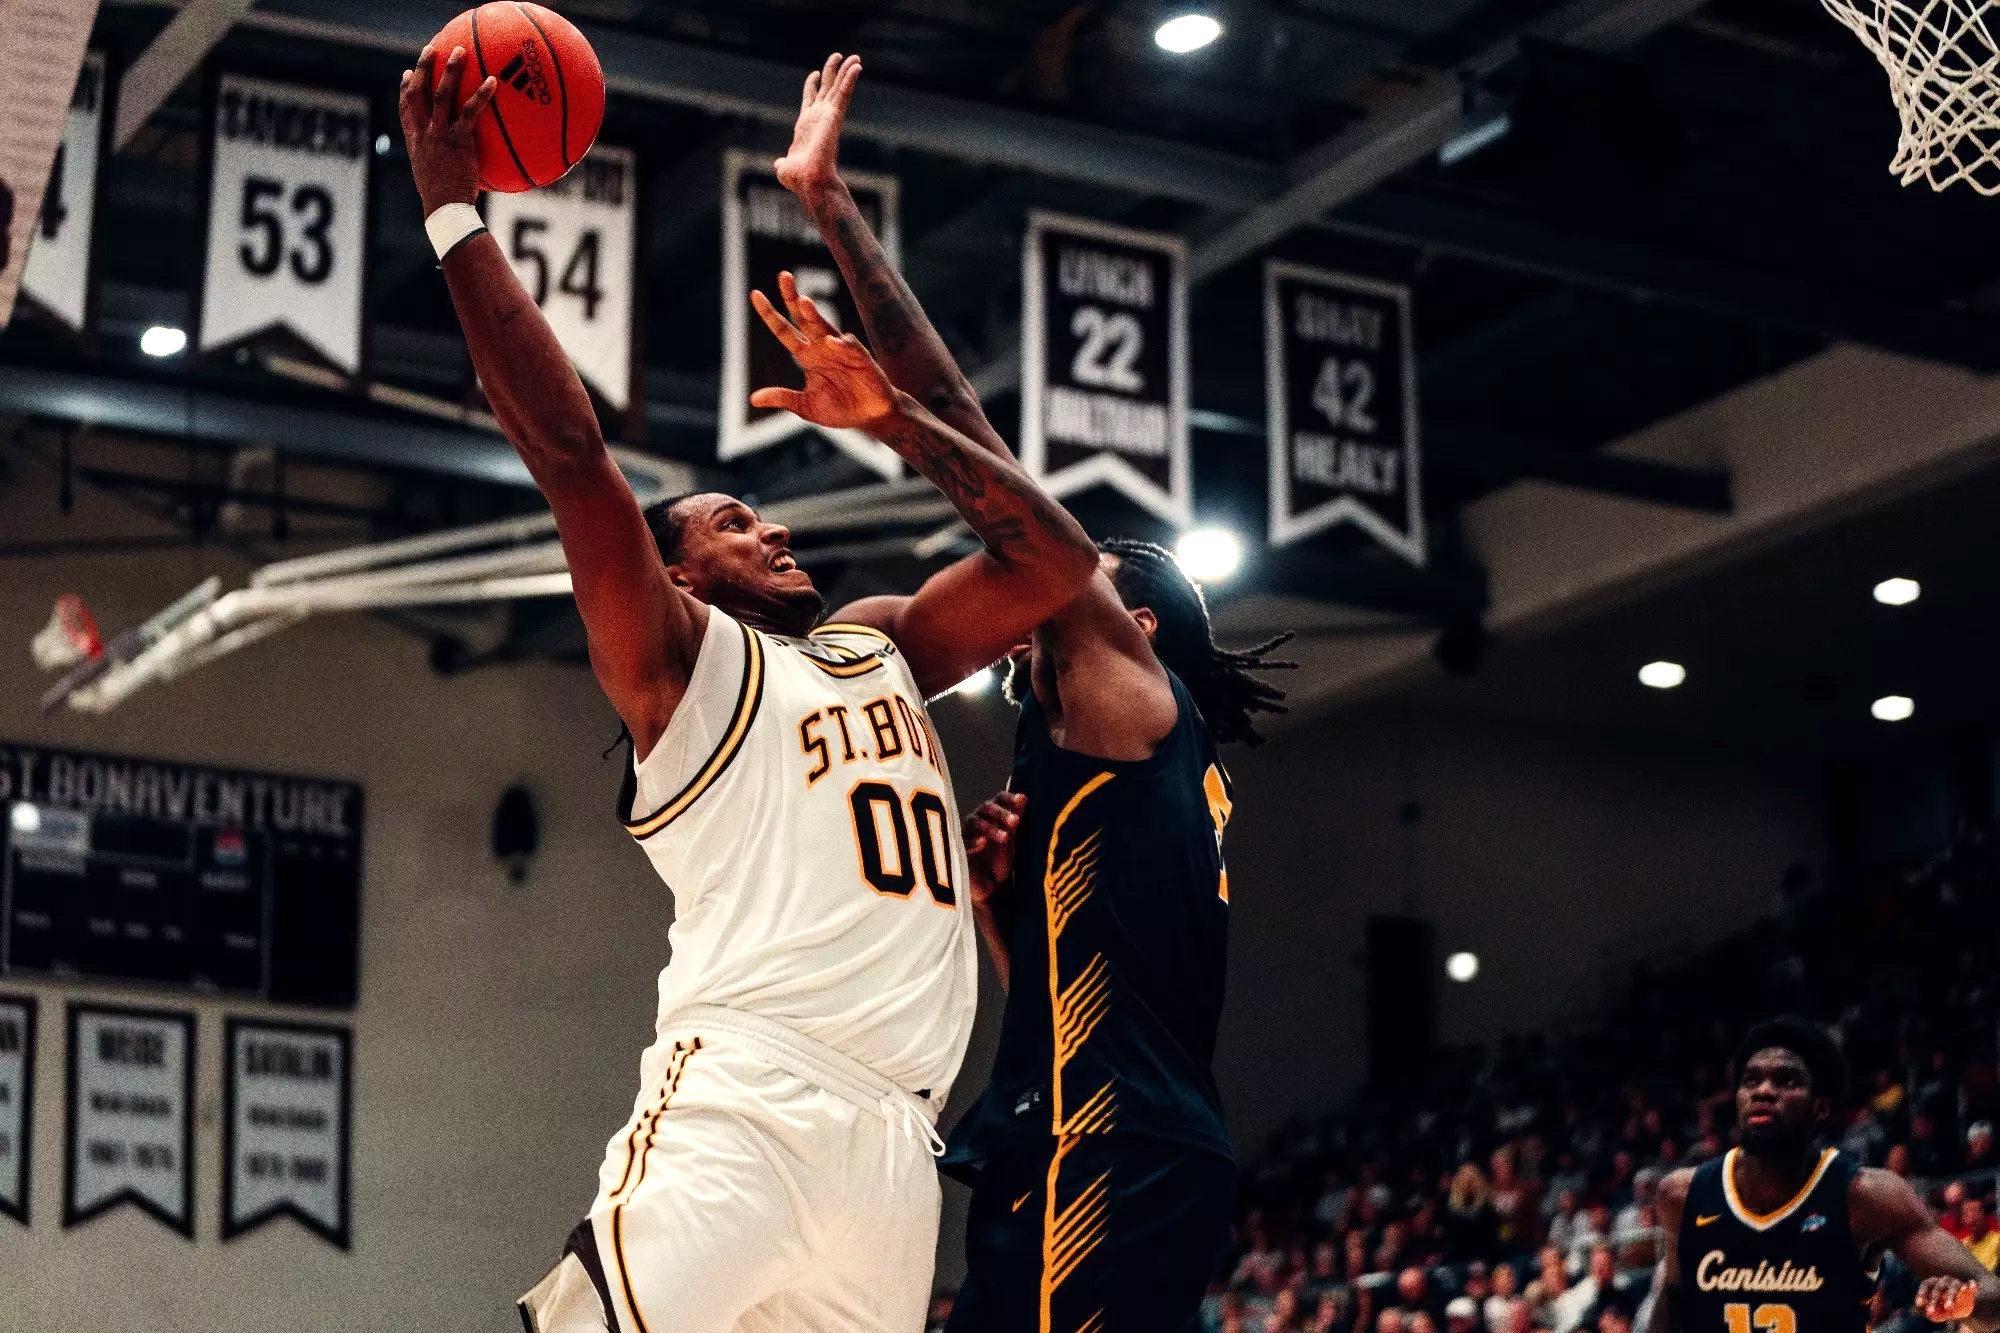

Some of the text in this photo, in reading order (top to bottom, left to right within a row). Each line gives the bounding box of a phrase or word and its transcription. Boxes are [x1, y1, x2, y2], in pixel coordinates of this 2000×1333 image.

[521, 39, 553, 106] adidas
[239, 175, 335, 285] 53
[511, 214, 605, 322] 54
[1070, 304, 1146, 394] 22
[1312, 354, 1377, 433] 42
[847, 778, 957, 909] 00
[1696, 1249, 1825, 1292] Canisius
